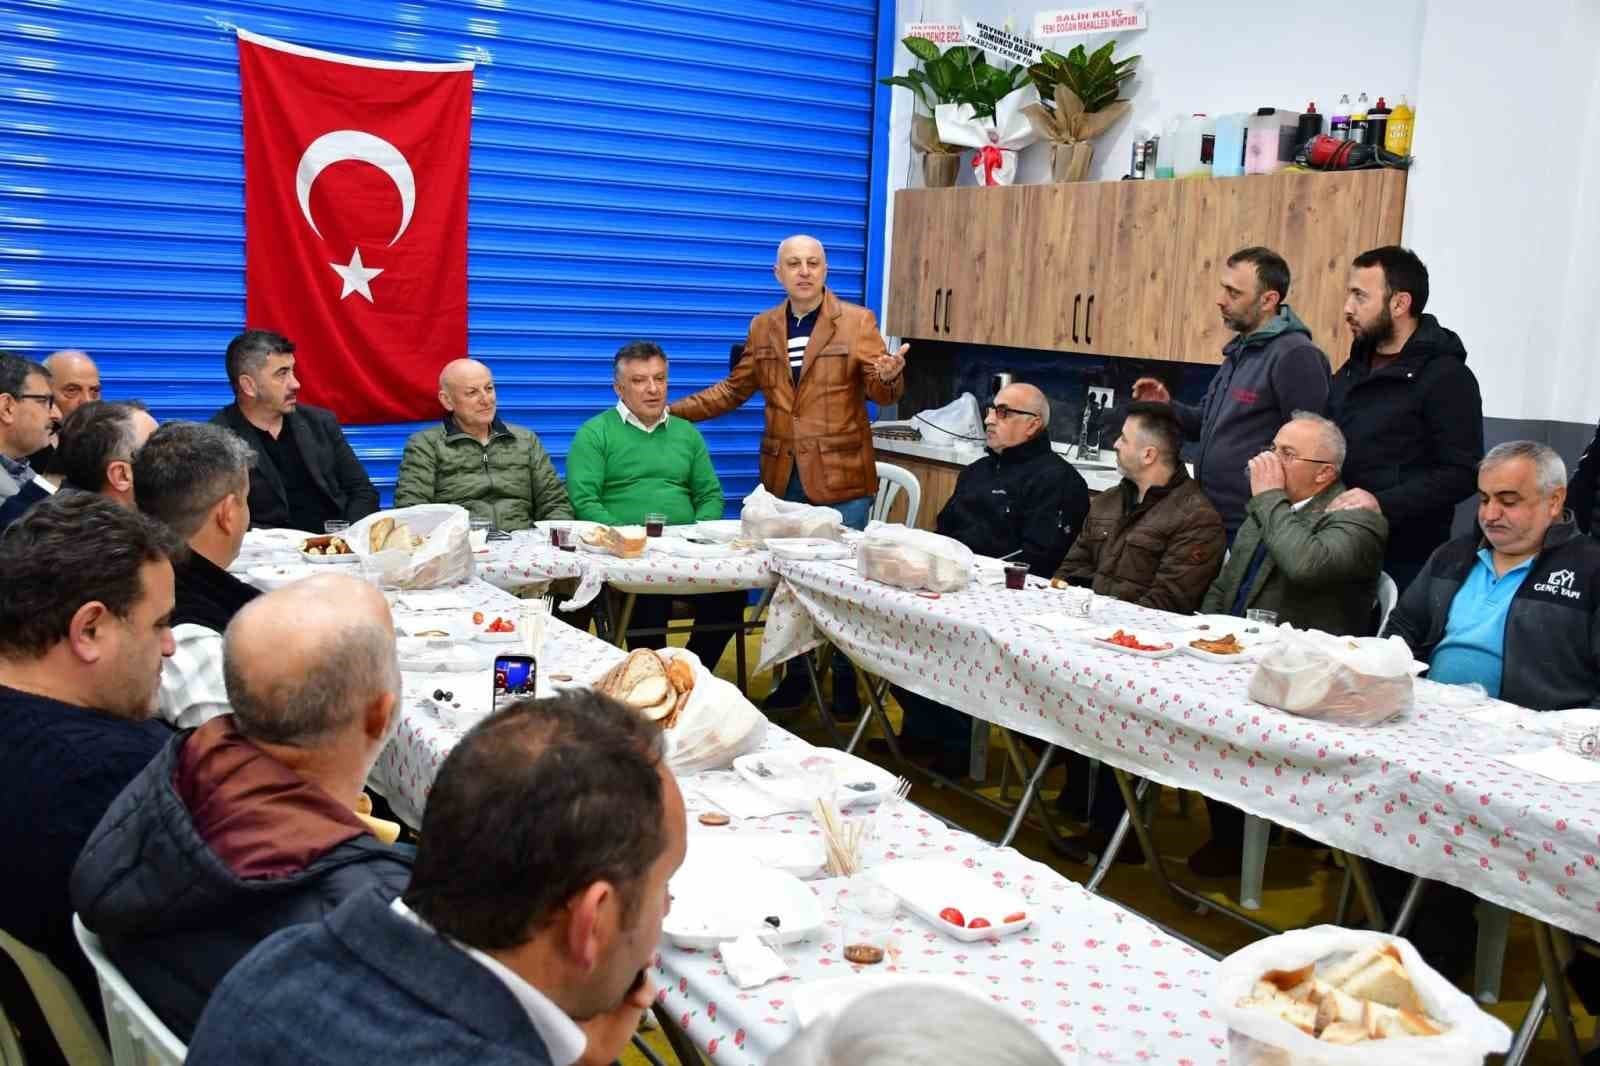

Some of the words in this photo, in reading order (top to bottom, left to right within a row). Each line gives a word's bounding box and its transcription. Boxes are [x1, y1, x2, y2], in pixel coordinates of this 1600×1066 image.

[967, 34, 997, 51] TRABZON
[976, 22, 1011, 39] HAYIRLI
[1013, 36, 1043, 52] OLSUN
[979, 30, 1013, 49] SOMUNCU
[1013, 43, 1033, 57] BABA
